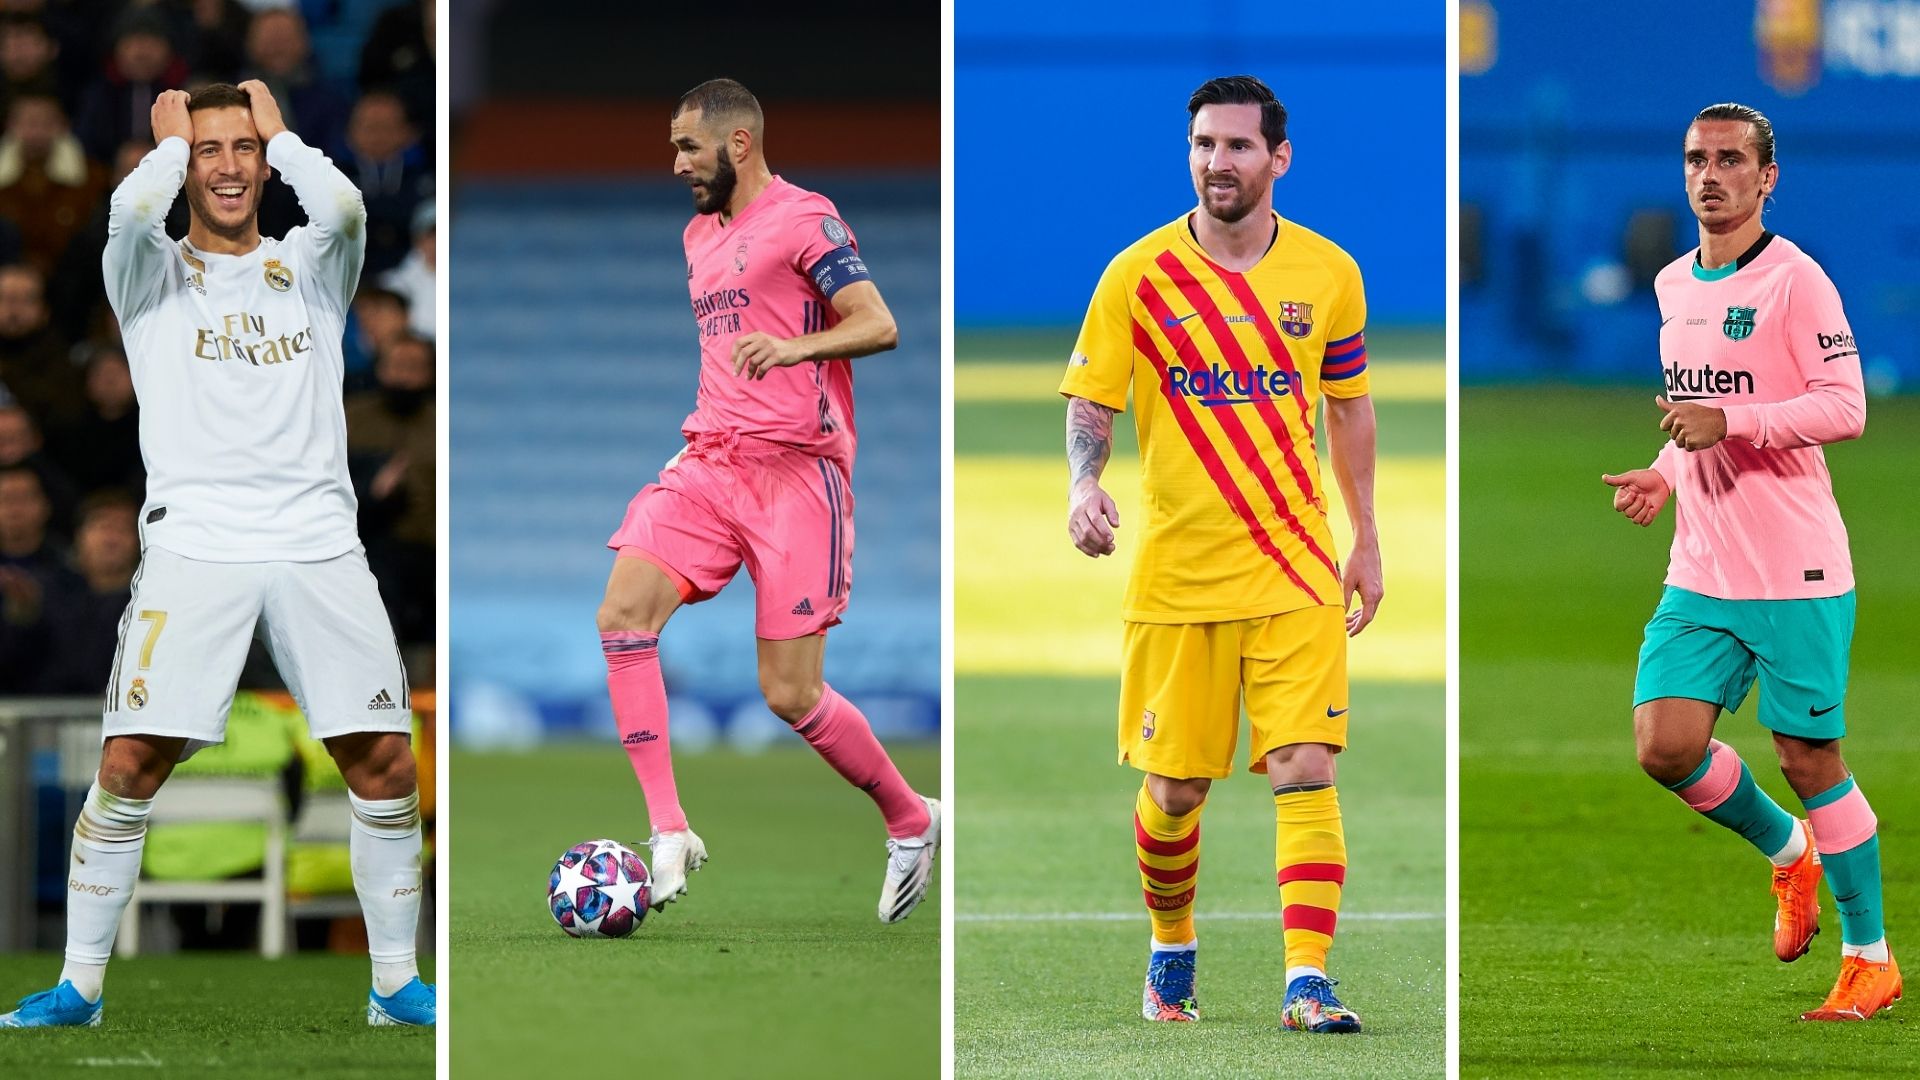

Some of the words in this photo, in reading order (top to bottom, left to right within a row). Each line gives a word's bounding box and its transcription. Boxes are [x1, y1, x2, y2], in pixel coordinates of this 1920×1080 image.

[223, 312, 265, 337] Fly
[707, 313, 741, 336] BETTER
[1168, 362, 1303, 397] Rakuten
[792, 608, 815, 616] adidas
[138, 610, 168, 670] 7
[367, 702, 396, 711] adidas
[623, 734, 659, 744] MADRID
[627, 730, 652, 739] REAL
[69, 880, 119, 896] RMCF
